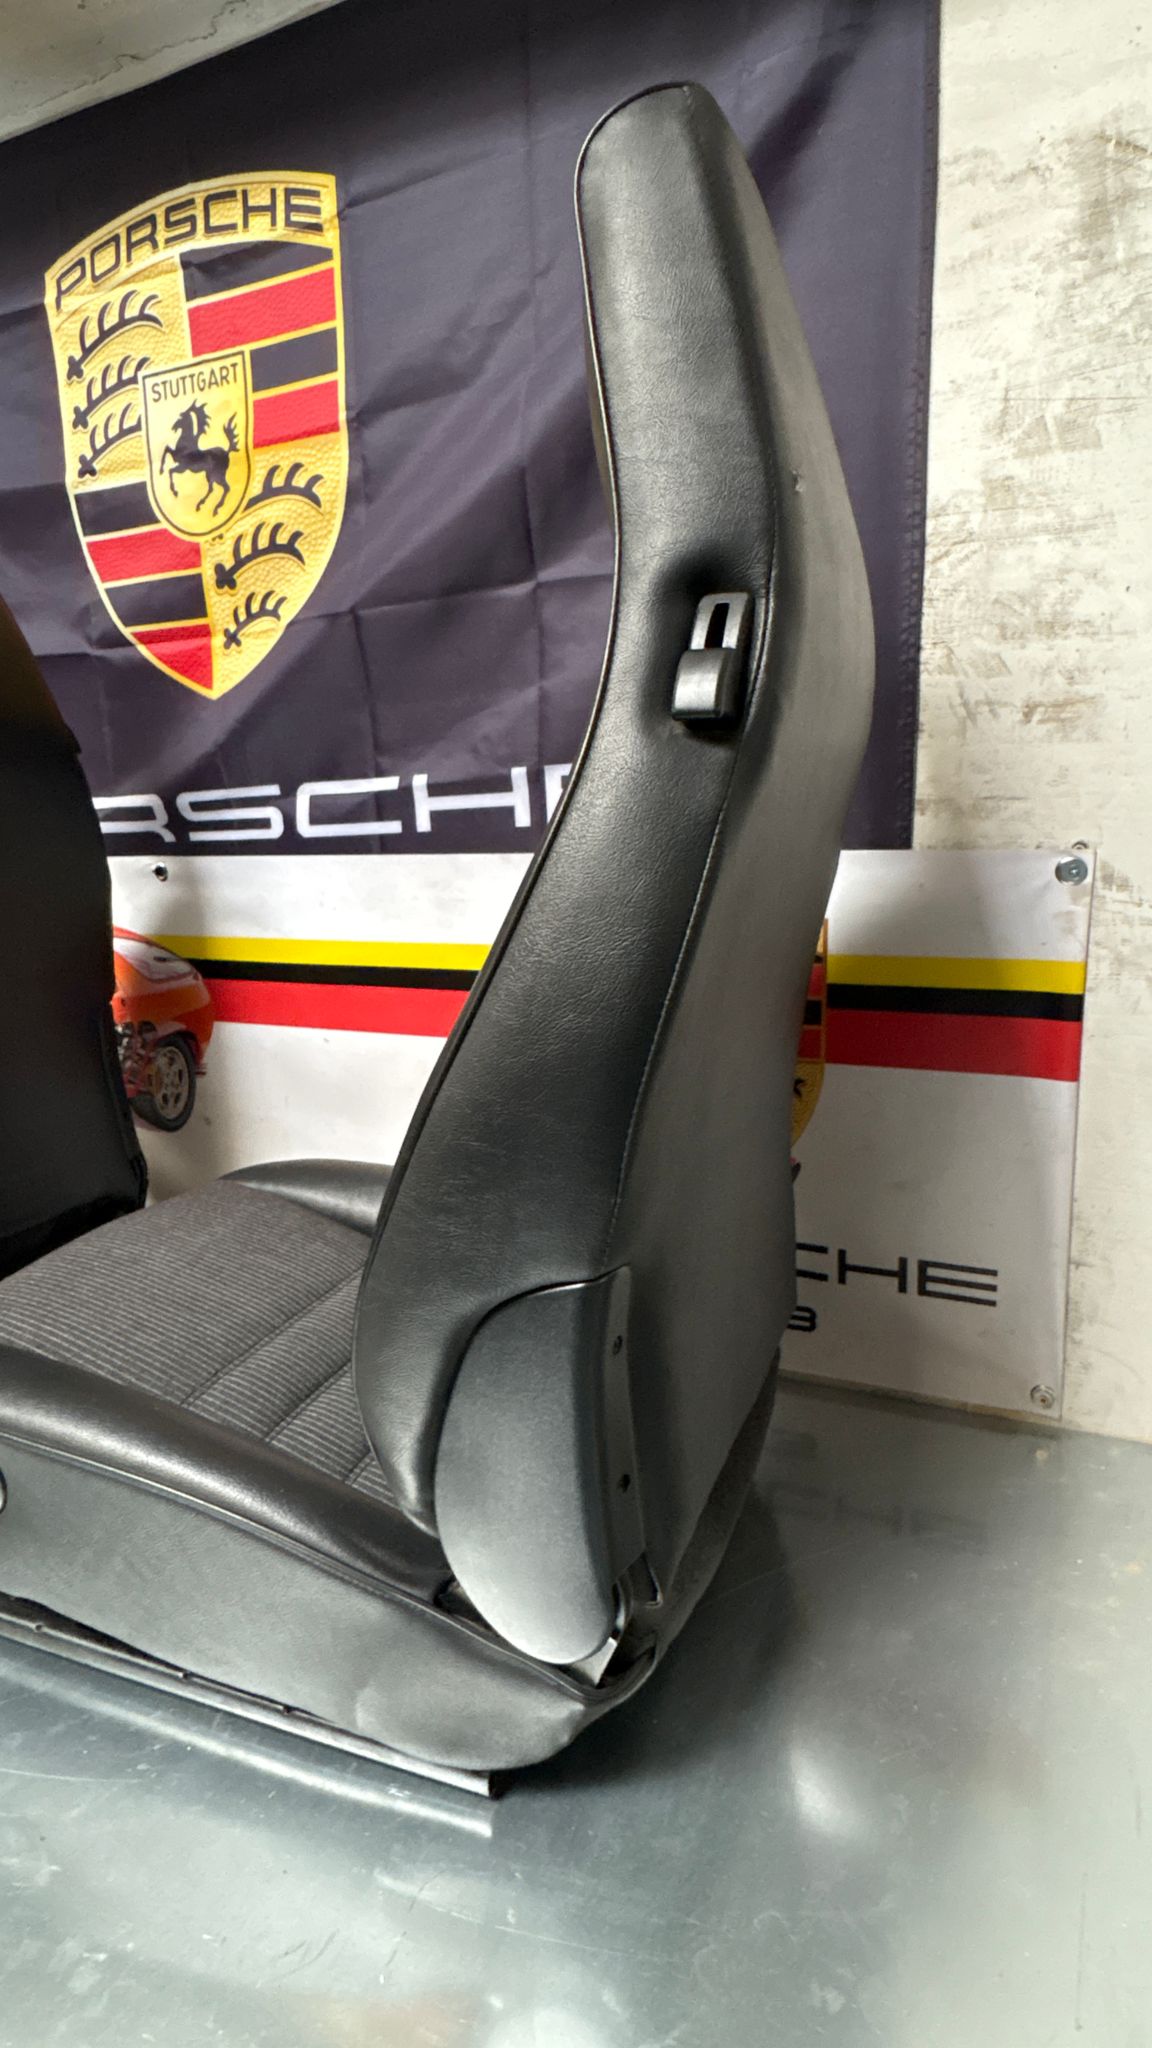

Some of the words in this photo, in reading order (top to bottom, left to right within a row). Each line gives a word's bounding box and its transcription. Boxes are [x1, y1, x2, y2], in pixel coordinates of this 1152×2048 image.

[55, 187, 324, 312] PORSCHE
[151, 363, 240, 402] STUTTGART
[92, 764, 572, 843] RSCH
